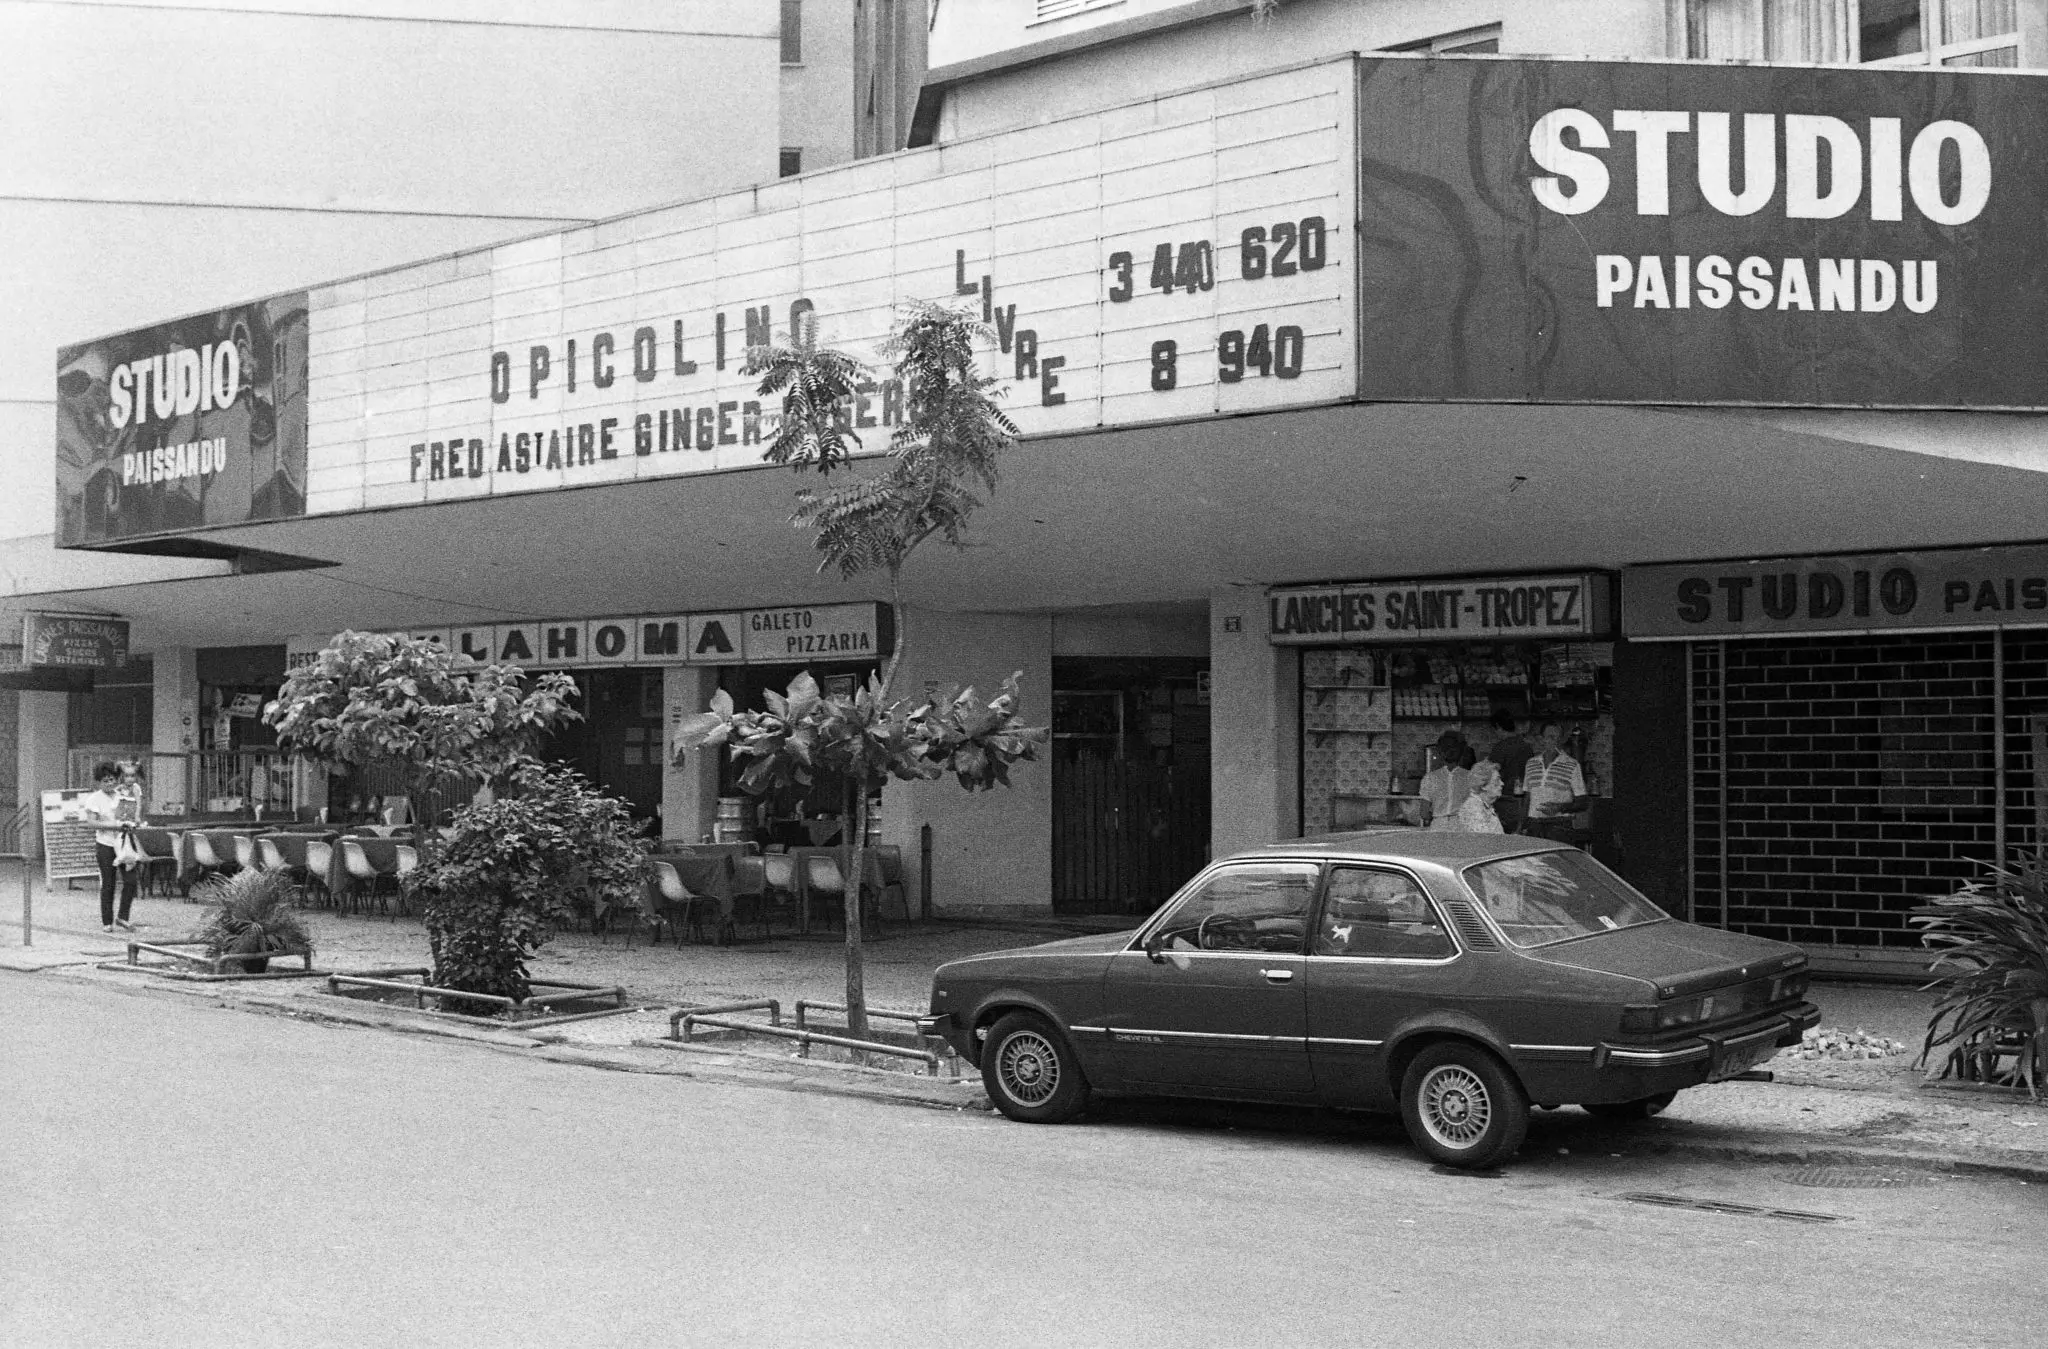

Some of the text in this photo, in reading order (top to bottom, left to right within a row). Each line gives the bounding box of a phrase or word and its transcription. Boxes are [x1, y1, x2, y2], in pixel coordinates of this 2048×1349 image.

[1530, 107, 1992, 226] STUDIO
[1109, 216, 1325, 301] 3 440 620
[1596, 254, 1938, 314] PAISSANDU
[956, 249, 1066, 406] LIVRE
[1151, 324, 1302, 391] 8 940
[109, 340, 240, 428] STUDIO
[123, 437, 227, 486] PAISSANDU
[410, 433, 482, 482] FRED
[497, 417, 618, 474] ASTAIRE
[634, 400, 761, 456] GINGER
[752, 611, 812, 631] GALETO
[1271, 585, 1581, 634] LANCHES SAINT-TROPEZ
[1676, 567, 1918, 624] STUDIO
[416, 620, 733, 661] LAHOMA
[786, 632, 870, 652] PIZZARIA
